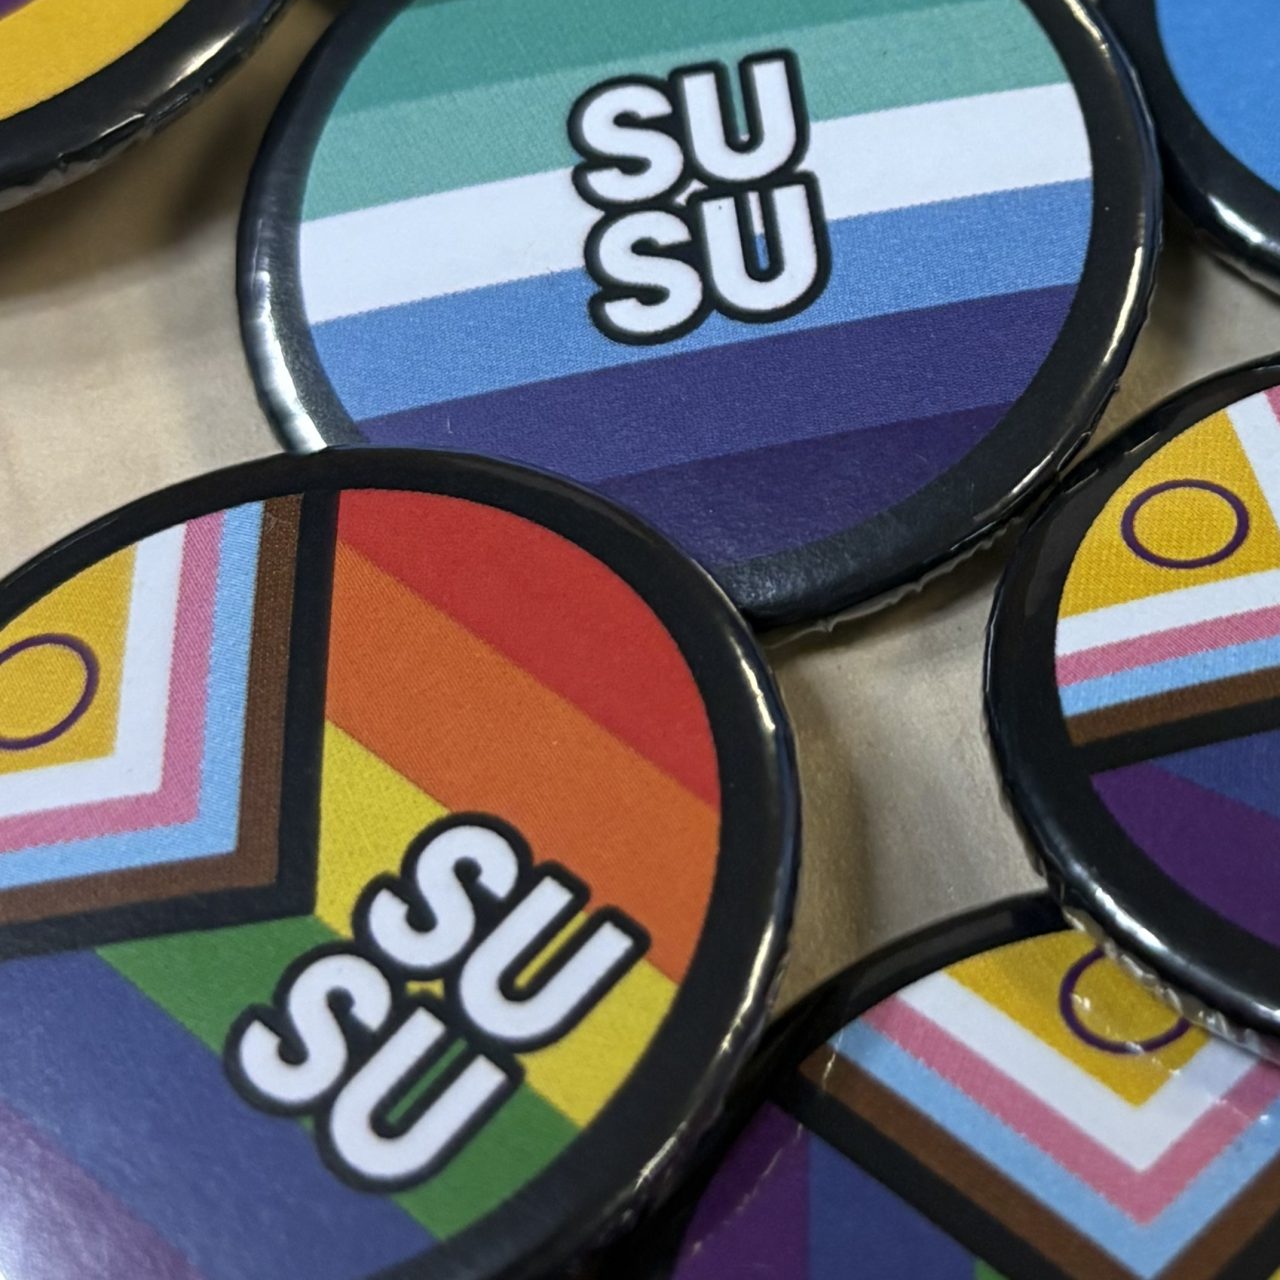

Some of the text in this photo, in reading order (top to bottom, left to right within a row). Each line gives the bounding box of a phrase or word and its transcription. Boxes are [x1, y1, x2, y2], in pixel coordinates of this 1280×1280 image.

[580, 58, 800, 205] SU
[598, 181, 821, 336] SU
[366, 823, 636, 1042] SU
[238, 952, 510, 1181] SU
